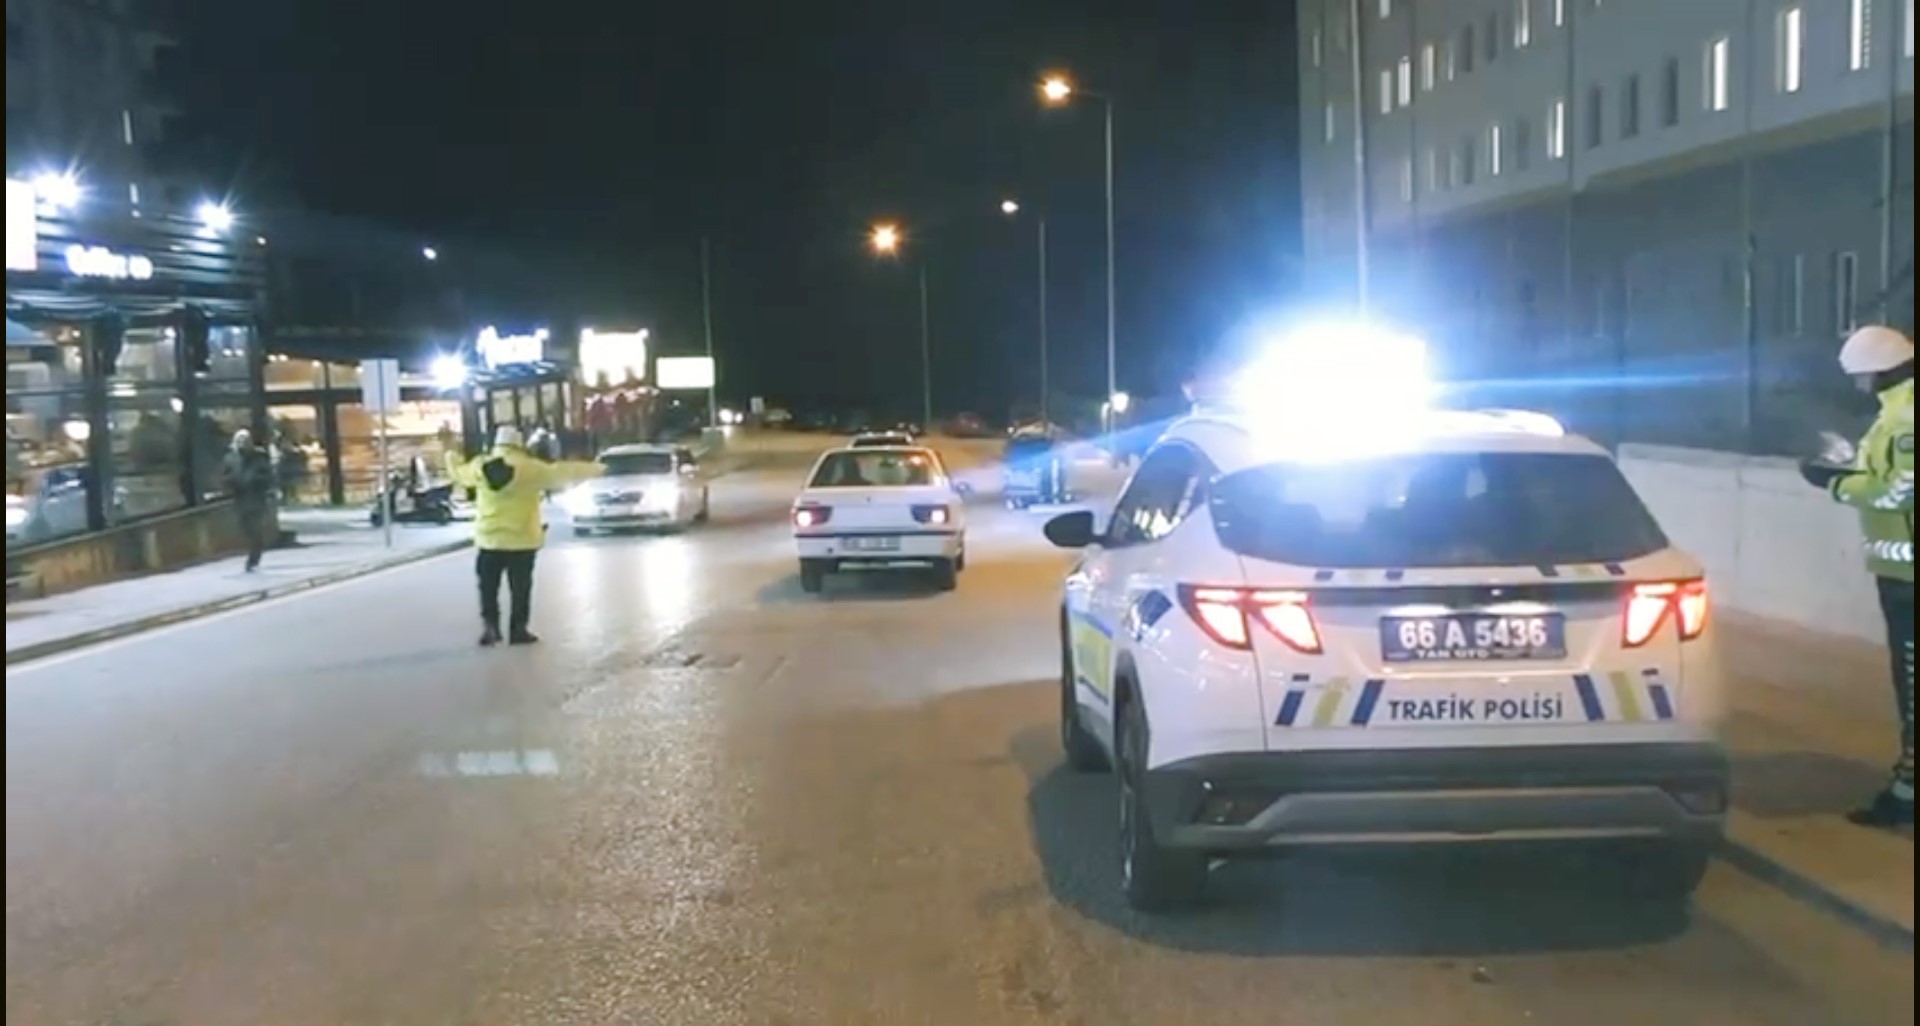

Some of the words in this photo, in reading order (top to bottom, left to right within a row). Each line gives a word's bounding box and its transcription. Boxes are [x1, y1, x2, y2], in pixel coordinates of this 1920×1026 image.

[1400, 619, 1437, 650] 66
[1445, 618, 1467, 649] A
[1474, 616, 1547, 648] 5436
[1388, 692, 1475, 721] TRAFİK
[1483, 691, 1563, 720] POLİSİ
